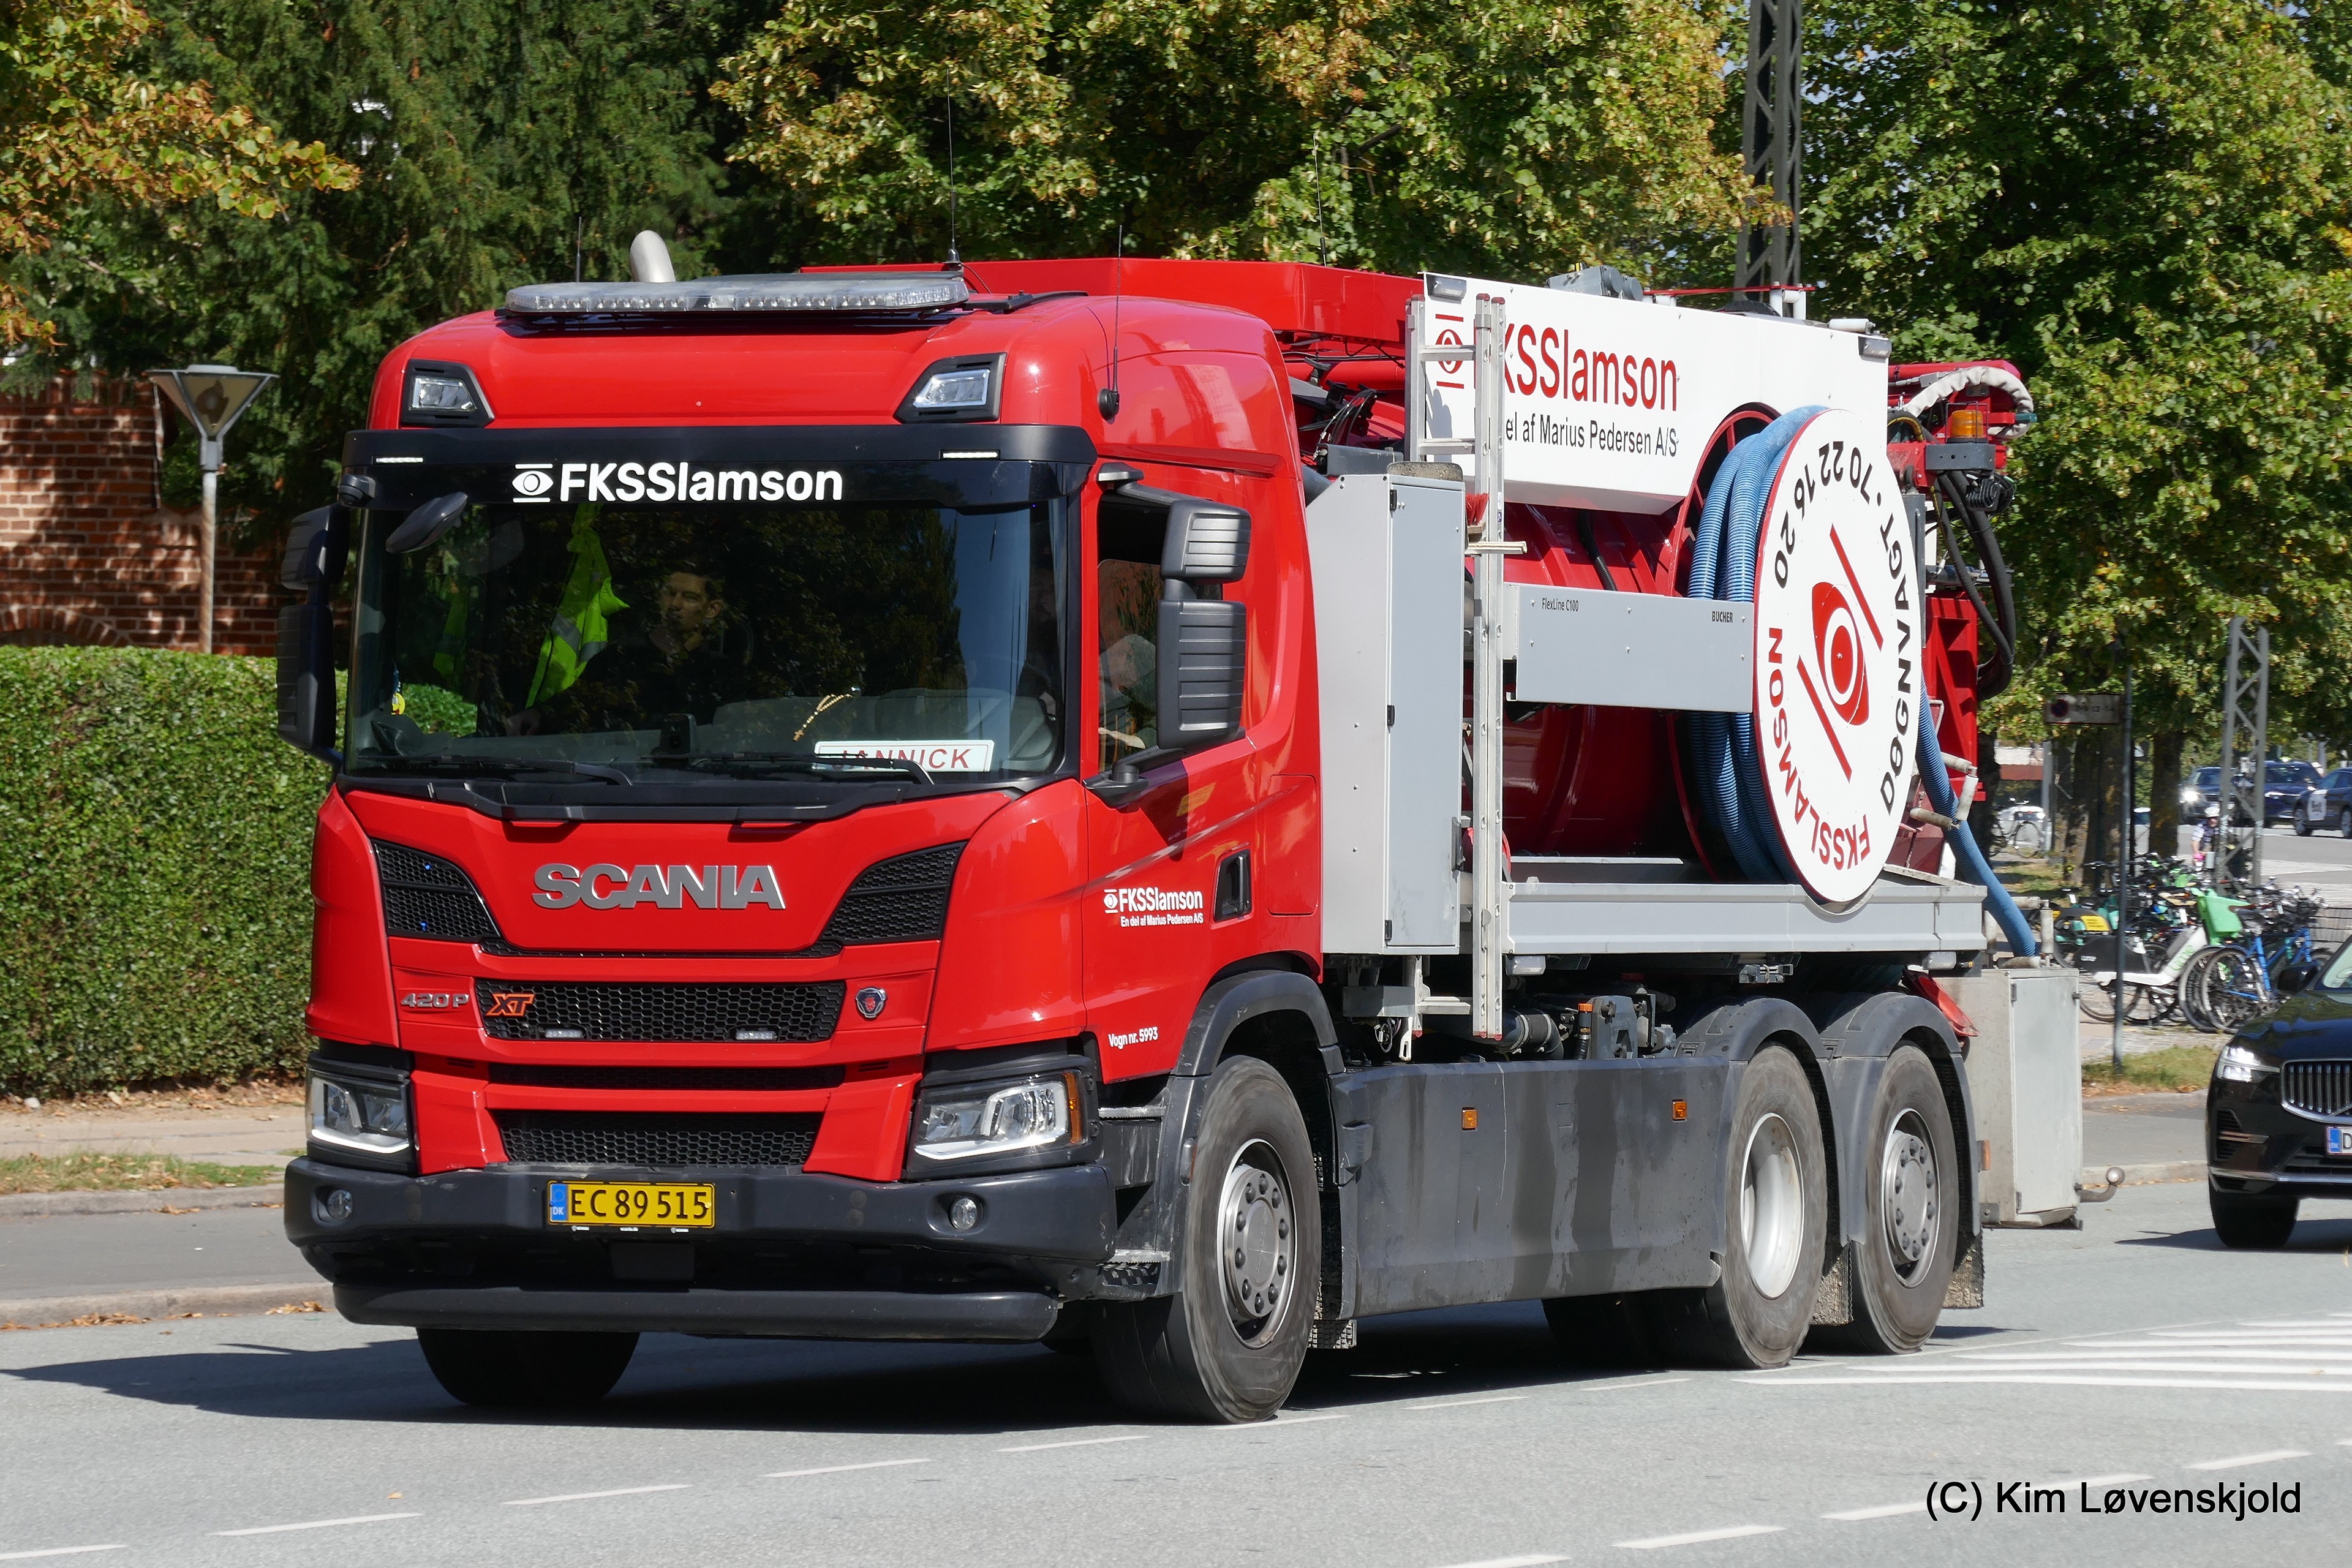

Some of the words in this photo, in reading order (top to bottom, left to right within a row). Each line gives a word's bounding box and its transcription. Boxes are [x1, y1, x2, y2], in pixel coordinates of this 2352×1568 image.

[1474, 319, 1677, 411] KSSlamson
[1504, 412, 1517, 441] el
[1523, 413, 1536, 443] af
[1540, 414, 1585, 448] Marius
[1590, 420, 1651, 455] Pedersen
[1655, 427, 1677, 457] A/S
[560, 462, 843, 502] FKSSlamson
[1819, 441, 1844, 486] 22
[1850, 447, 1873, 505] 70
[1794, 464, 1815, 521] 16
[1774, 510, 1795, 589] 20
[1542, 597, 1564, 611] FlexLine
[1566, 600, 1579, 611] C100
[1711, 611, 1733, 623] BUCHER
[1880, 512, 1912, 816] DØGNVAGT
[1768, 628, 1871, 870] FKSSLAMSON
[532, 863, 786, 910] SCANIA
[1118, 887, 1203, 912] FKSSlamson
[1120, 916, 1129, 927] En
[1130, 915, 1139, 926] del
[1140, 914, 1147, 926] af
[1147, 914, 1166, 925] Marius
[1167, 913, 1193, 925] Pedersen
[1194, 912, 1204, 924] A/S
[401, 993, 450, 1008] 420
[453, 993, 469, 1008] P
[486, 993, 535, 1017] XT
[1108, 1033, 1128, 1050] Vogn
[1128, 1033, 1139, 1044] nr.
[1139, 1027, 1158, 1042] 5993
[552, 1207, 564, 1215] DK
[571, 1189, 606, 1217] EC
[615, 1189, 648, 1219] 89
[657, 1191, 709, 1219] 515
